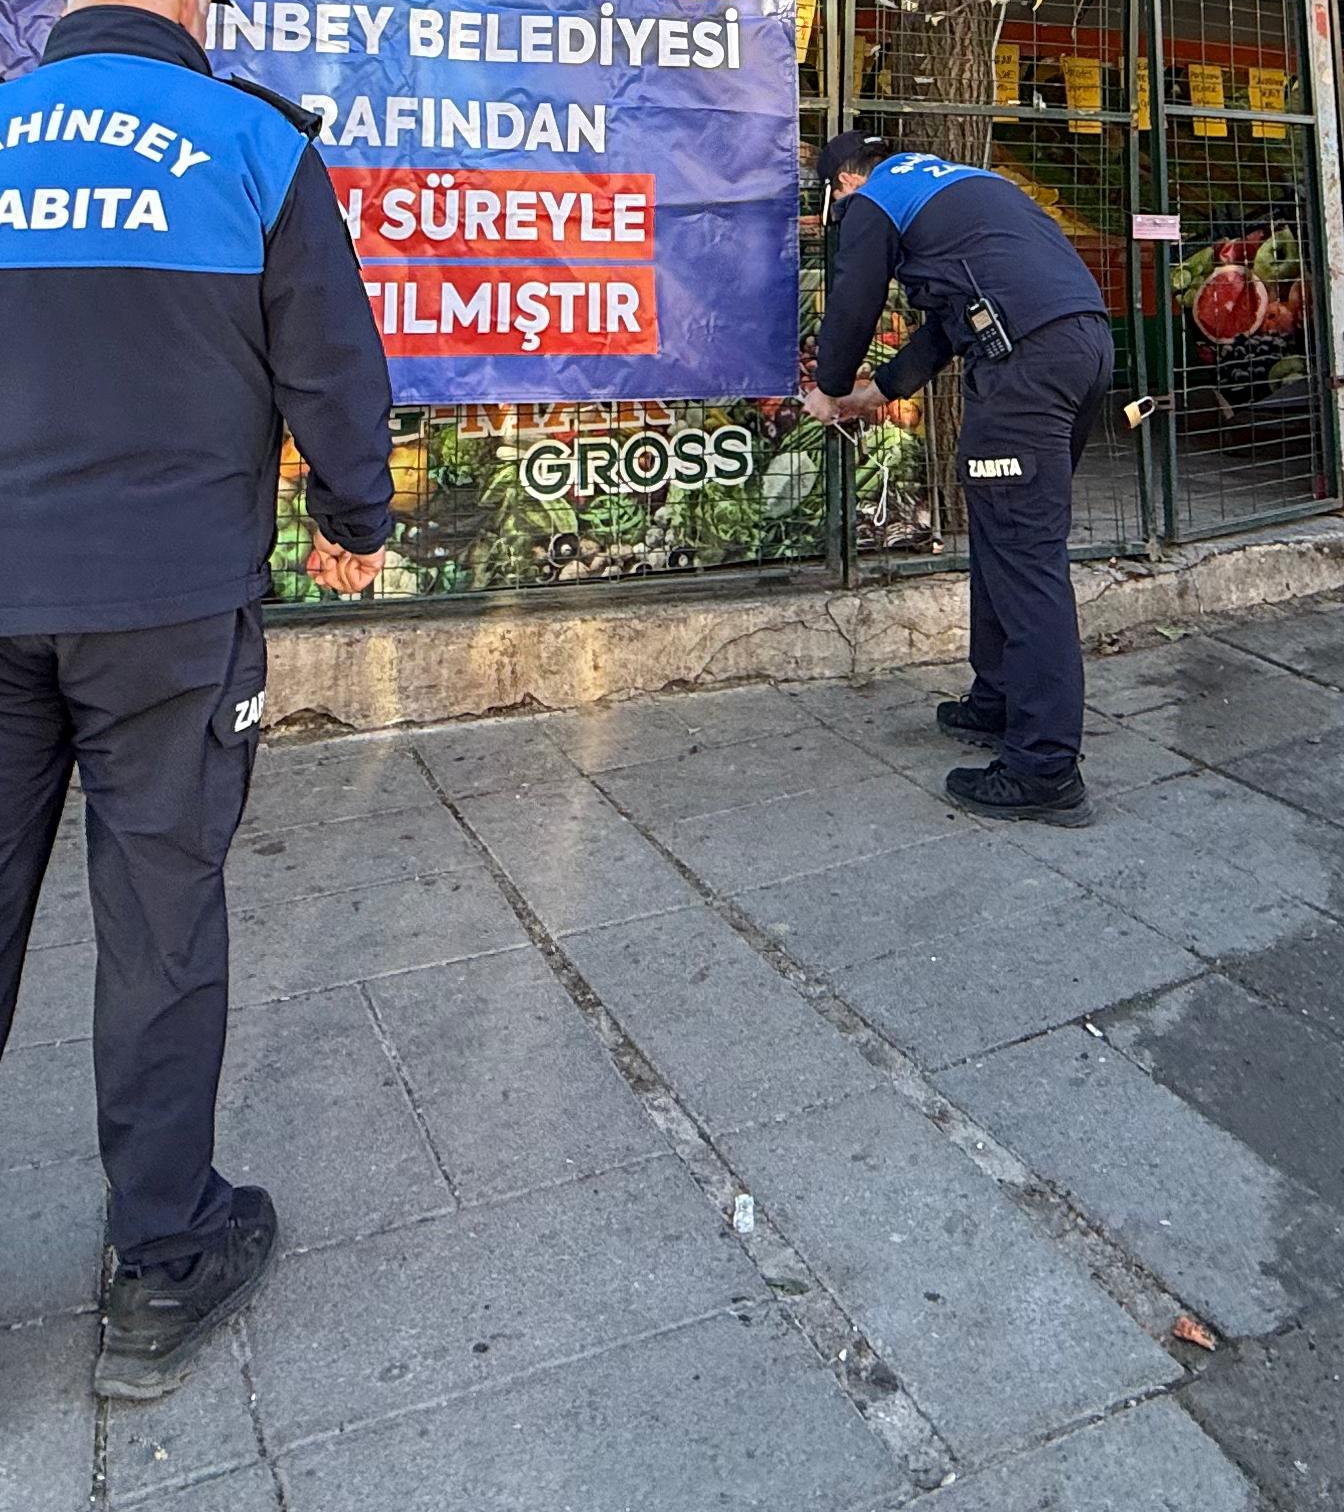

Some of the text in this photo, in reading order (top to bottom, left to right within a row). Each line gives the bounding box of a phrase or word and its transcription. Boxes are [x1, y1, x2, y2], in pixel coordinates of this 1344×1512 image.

[408, 1, 741, 70] BELEDİYESİ
[300, 93, 607, 154] RAFINDAN
[378, 172, 647, 242] SÜREYLE
[520, 425, 759, 501] GROSS
[968, 457, 1022, 478] ZABITA
